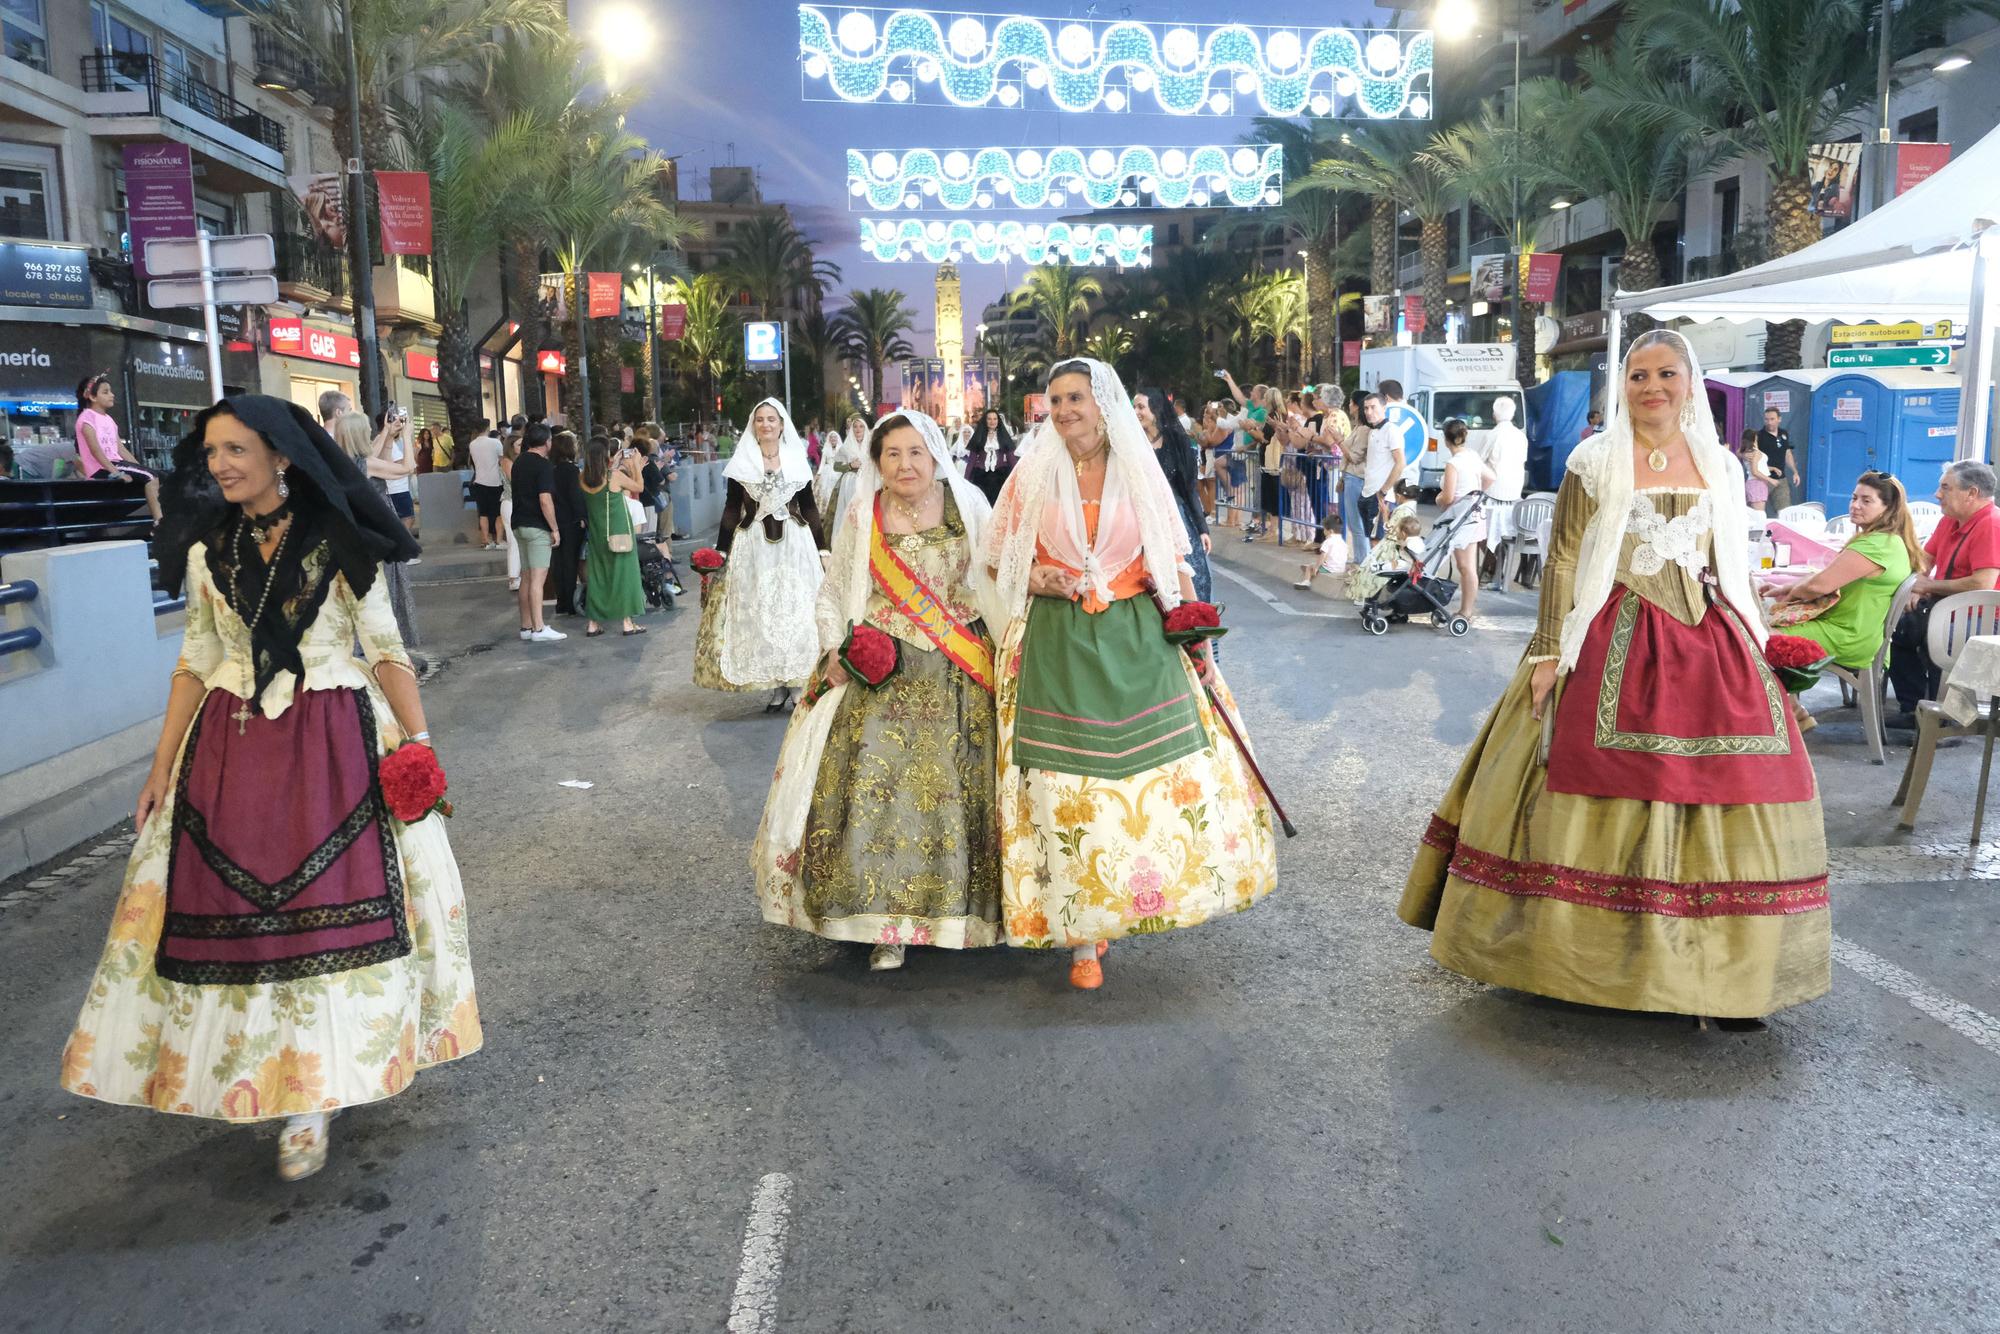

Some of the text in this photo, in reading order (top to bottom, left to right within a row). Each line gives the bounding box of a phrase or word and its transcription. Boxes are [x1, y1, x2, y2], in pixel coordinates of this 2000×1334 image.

[134, 157, 182, 165] FISIONATURE
[24, 262, 82, 274] 966 297 435
[25, 271, 82, 283] 678 367 656
[5, 289, 85, 301] locales chalets
[272, 327, 301, 339] GAES
[1833, 328, 1910, 338] Estación autobuses
[310, 333, 337, 359] GAES
[1833, 355, 1856, 363] Gran
[135, 358, 205, 381] Dermocosmética
